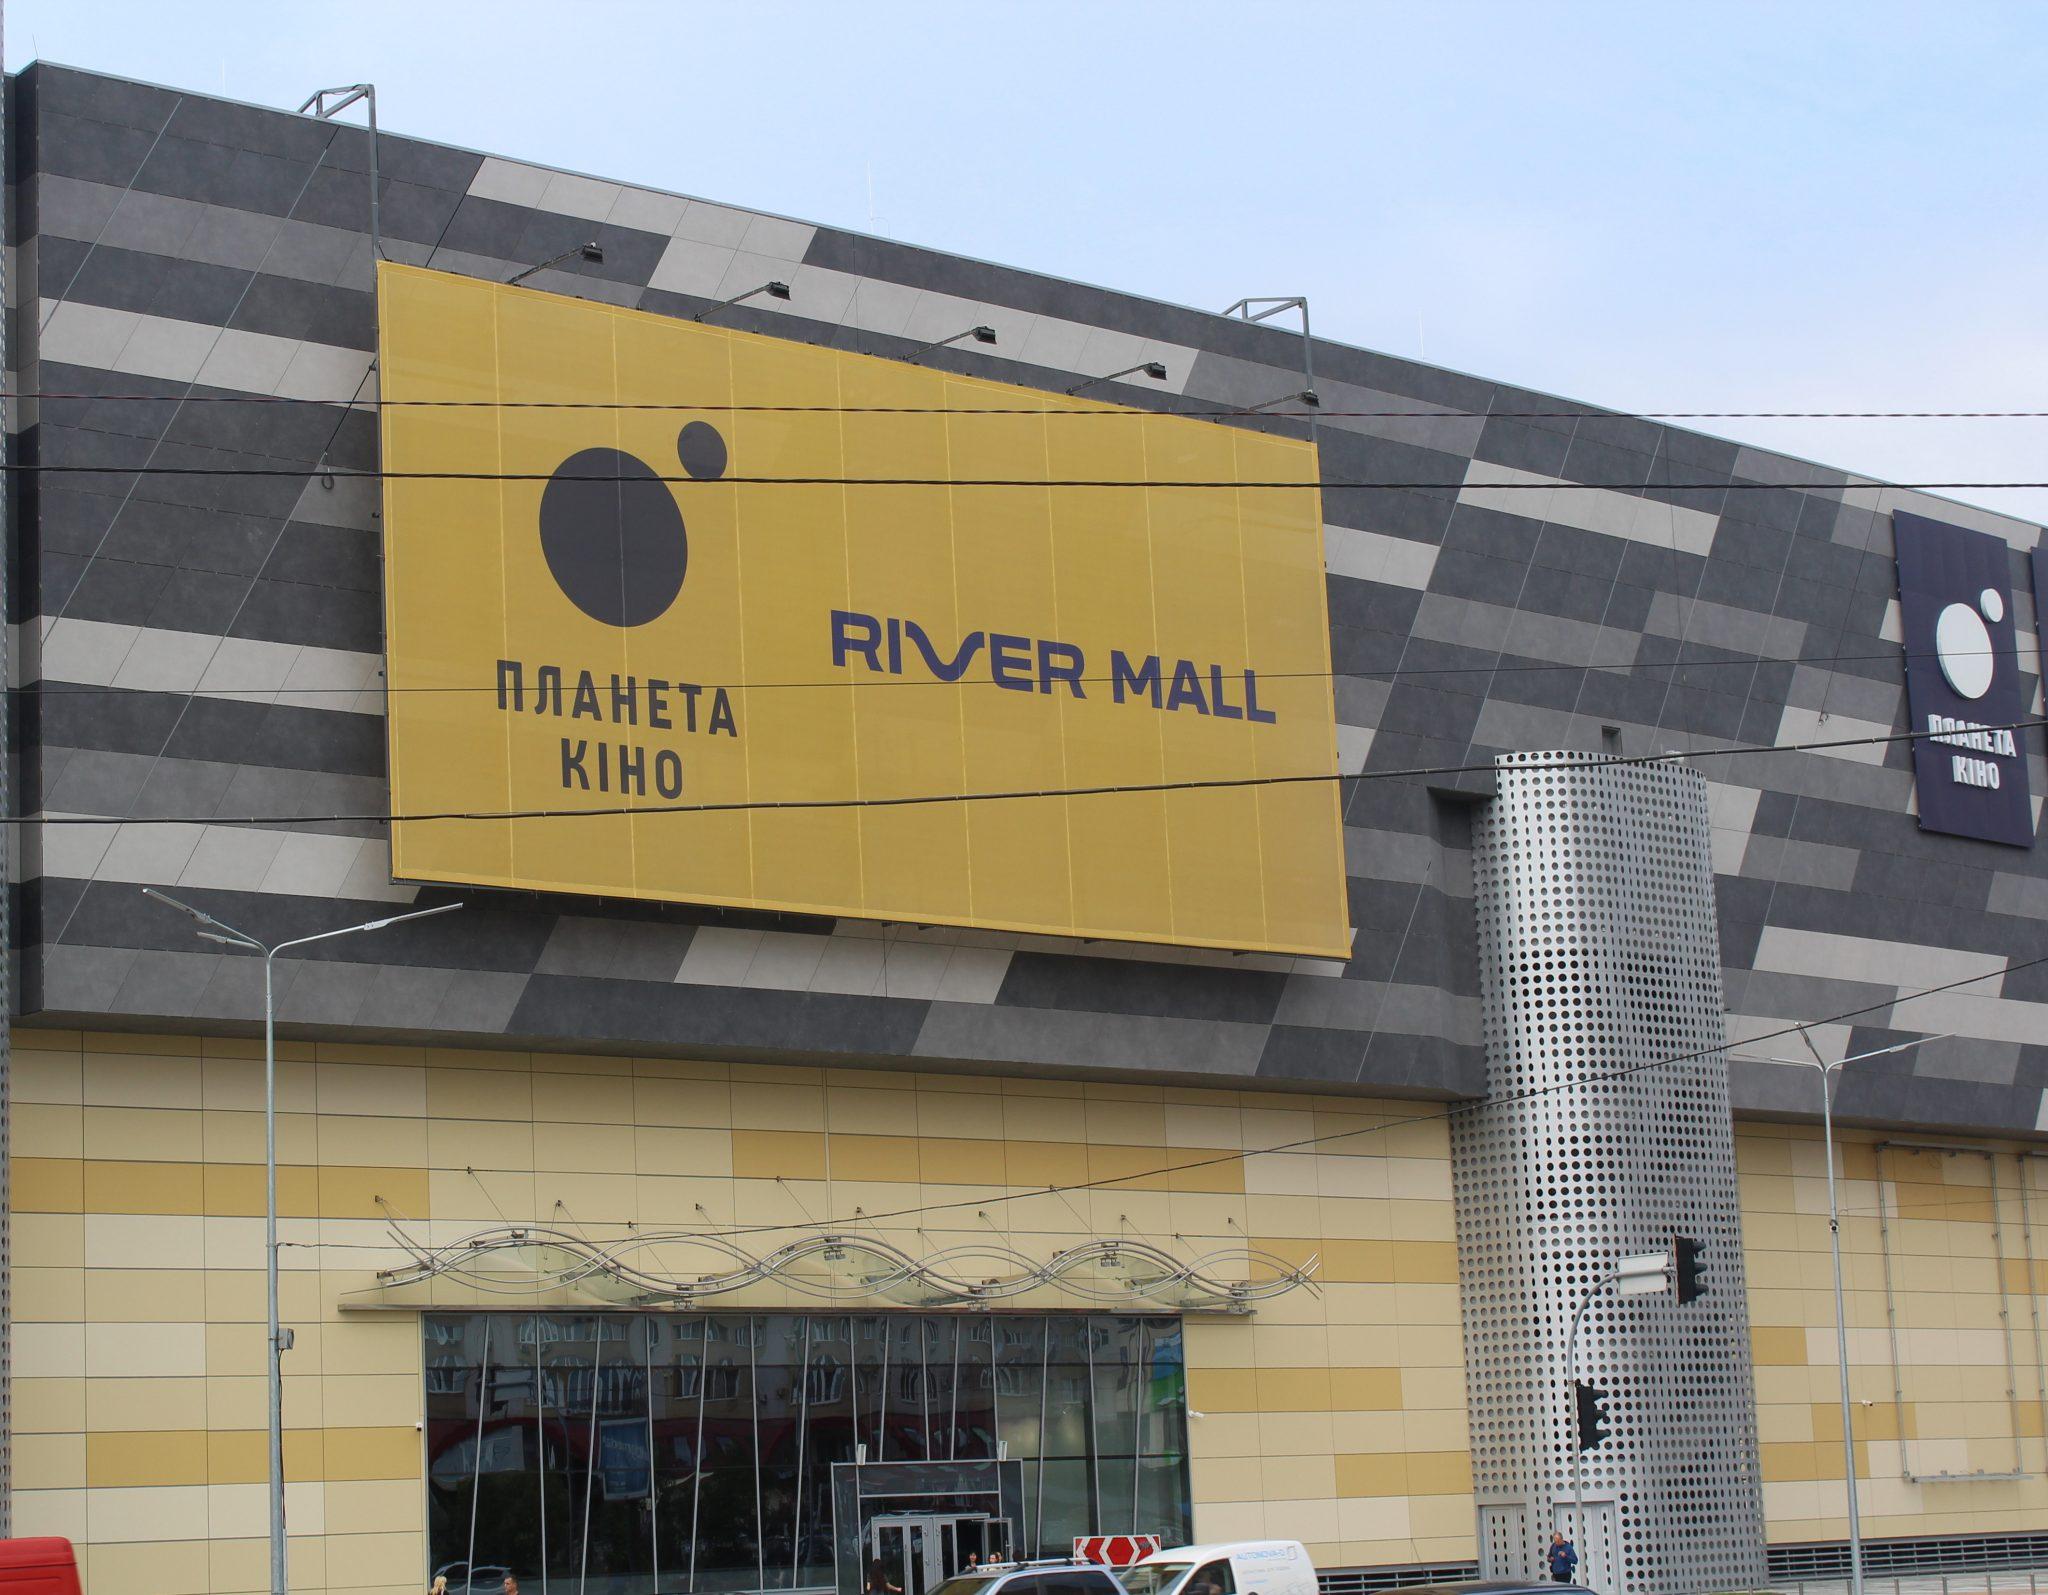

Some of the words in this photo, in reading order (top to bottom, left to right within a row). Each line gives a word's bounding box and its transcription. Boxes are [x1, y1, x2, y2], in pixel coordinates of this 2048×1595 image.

[831, 609, 1088, 700] RIVER
[1110, 649, 1277, 724] MALL
[497, 659, 738, 737] ПЛАНЕТА
[1928, 714, 2017, 757] ПЛАНЕТА
[561, 738, 683, 799] КІНО
[1952, 755, 2000, 789] КІНО
